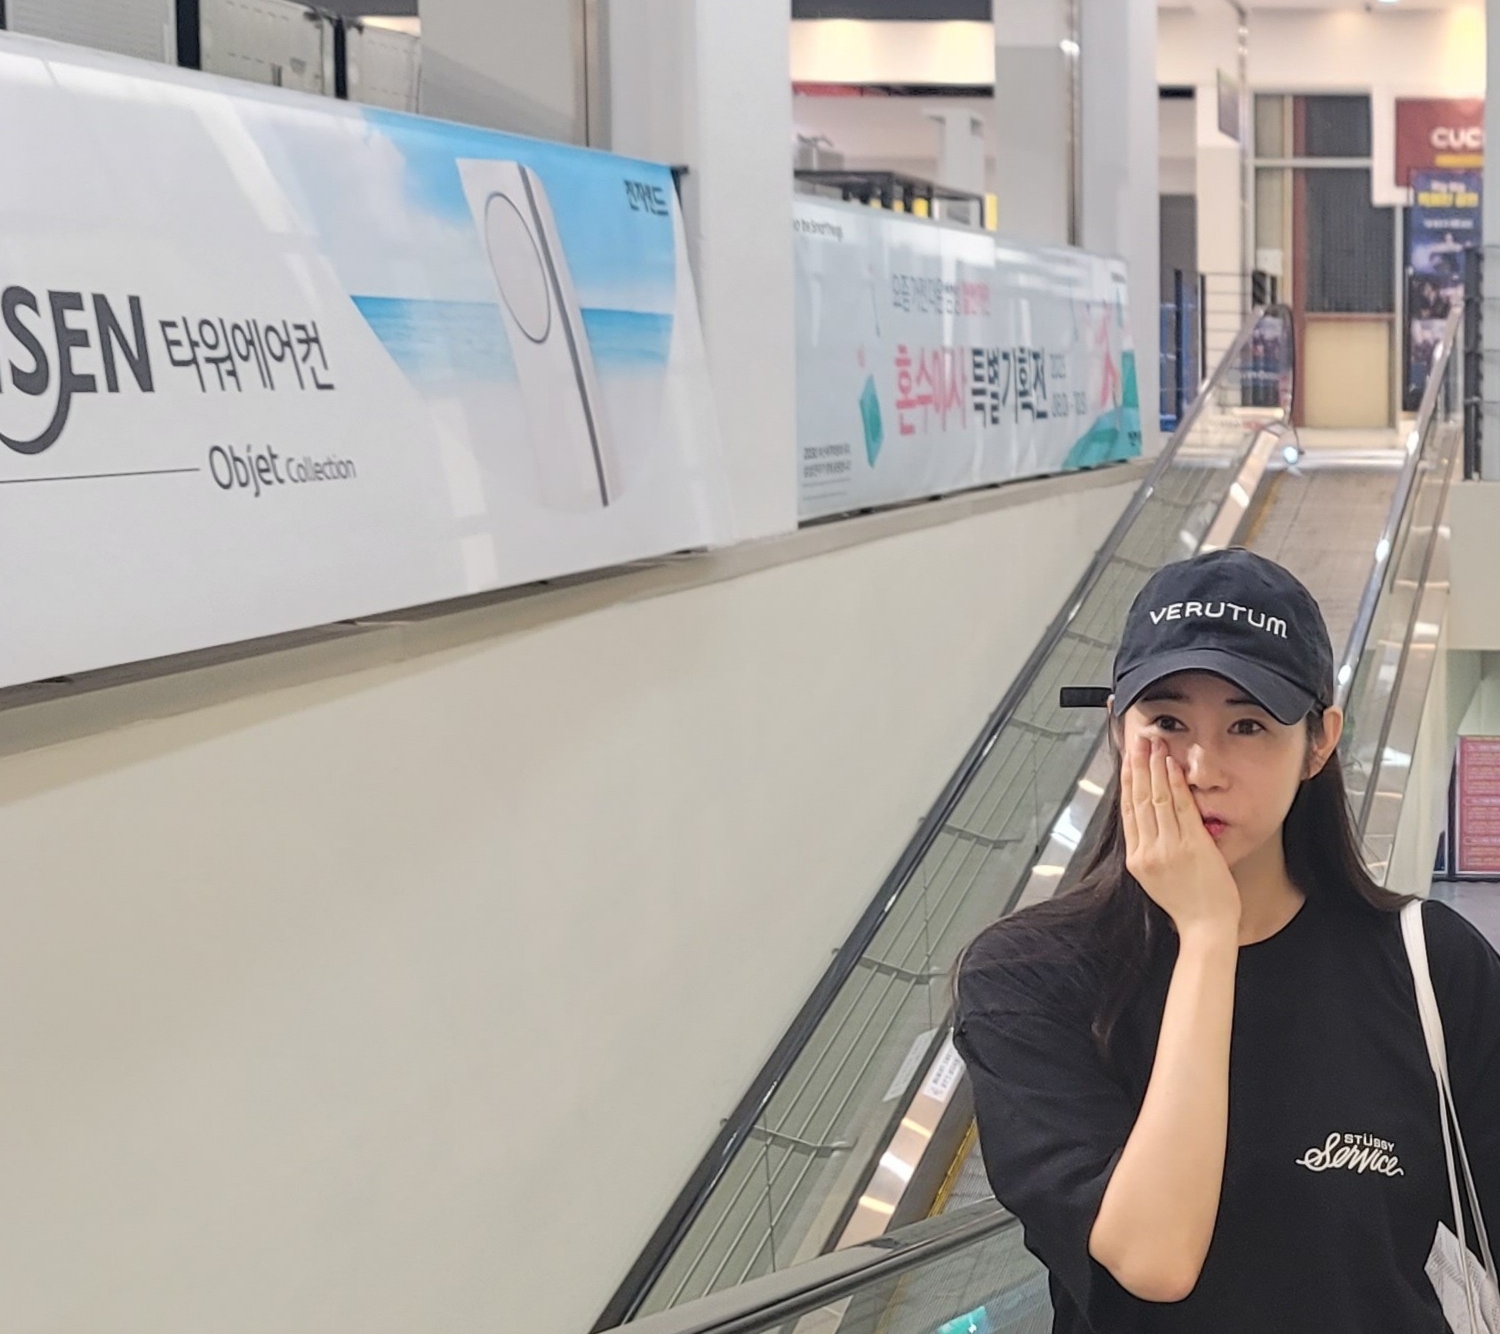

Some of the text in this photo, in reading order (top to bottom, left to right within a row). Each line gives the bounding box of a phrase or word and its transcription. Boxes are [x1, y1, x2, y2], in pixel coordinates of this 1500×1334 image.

[0, 285, 336, 455] SEN 타워에어컨
[208, 444, 358, 498] Objet Collection
[1149, 601, 1288, 639] VERUTUM
[1294, 1131, 1406, 1178] Service
